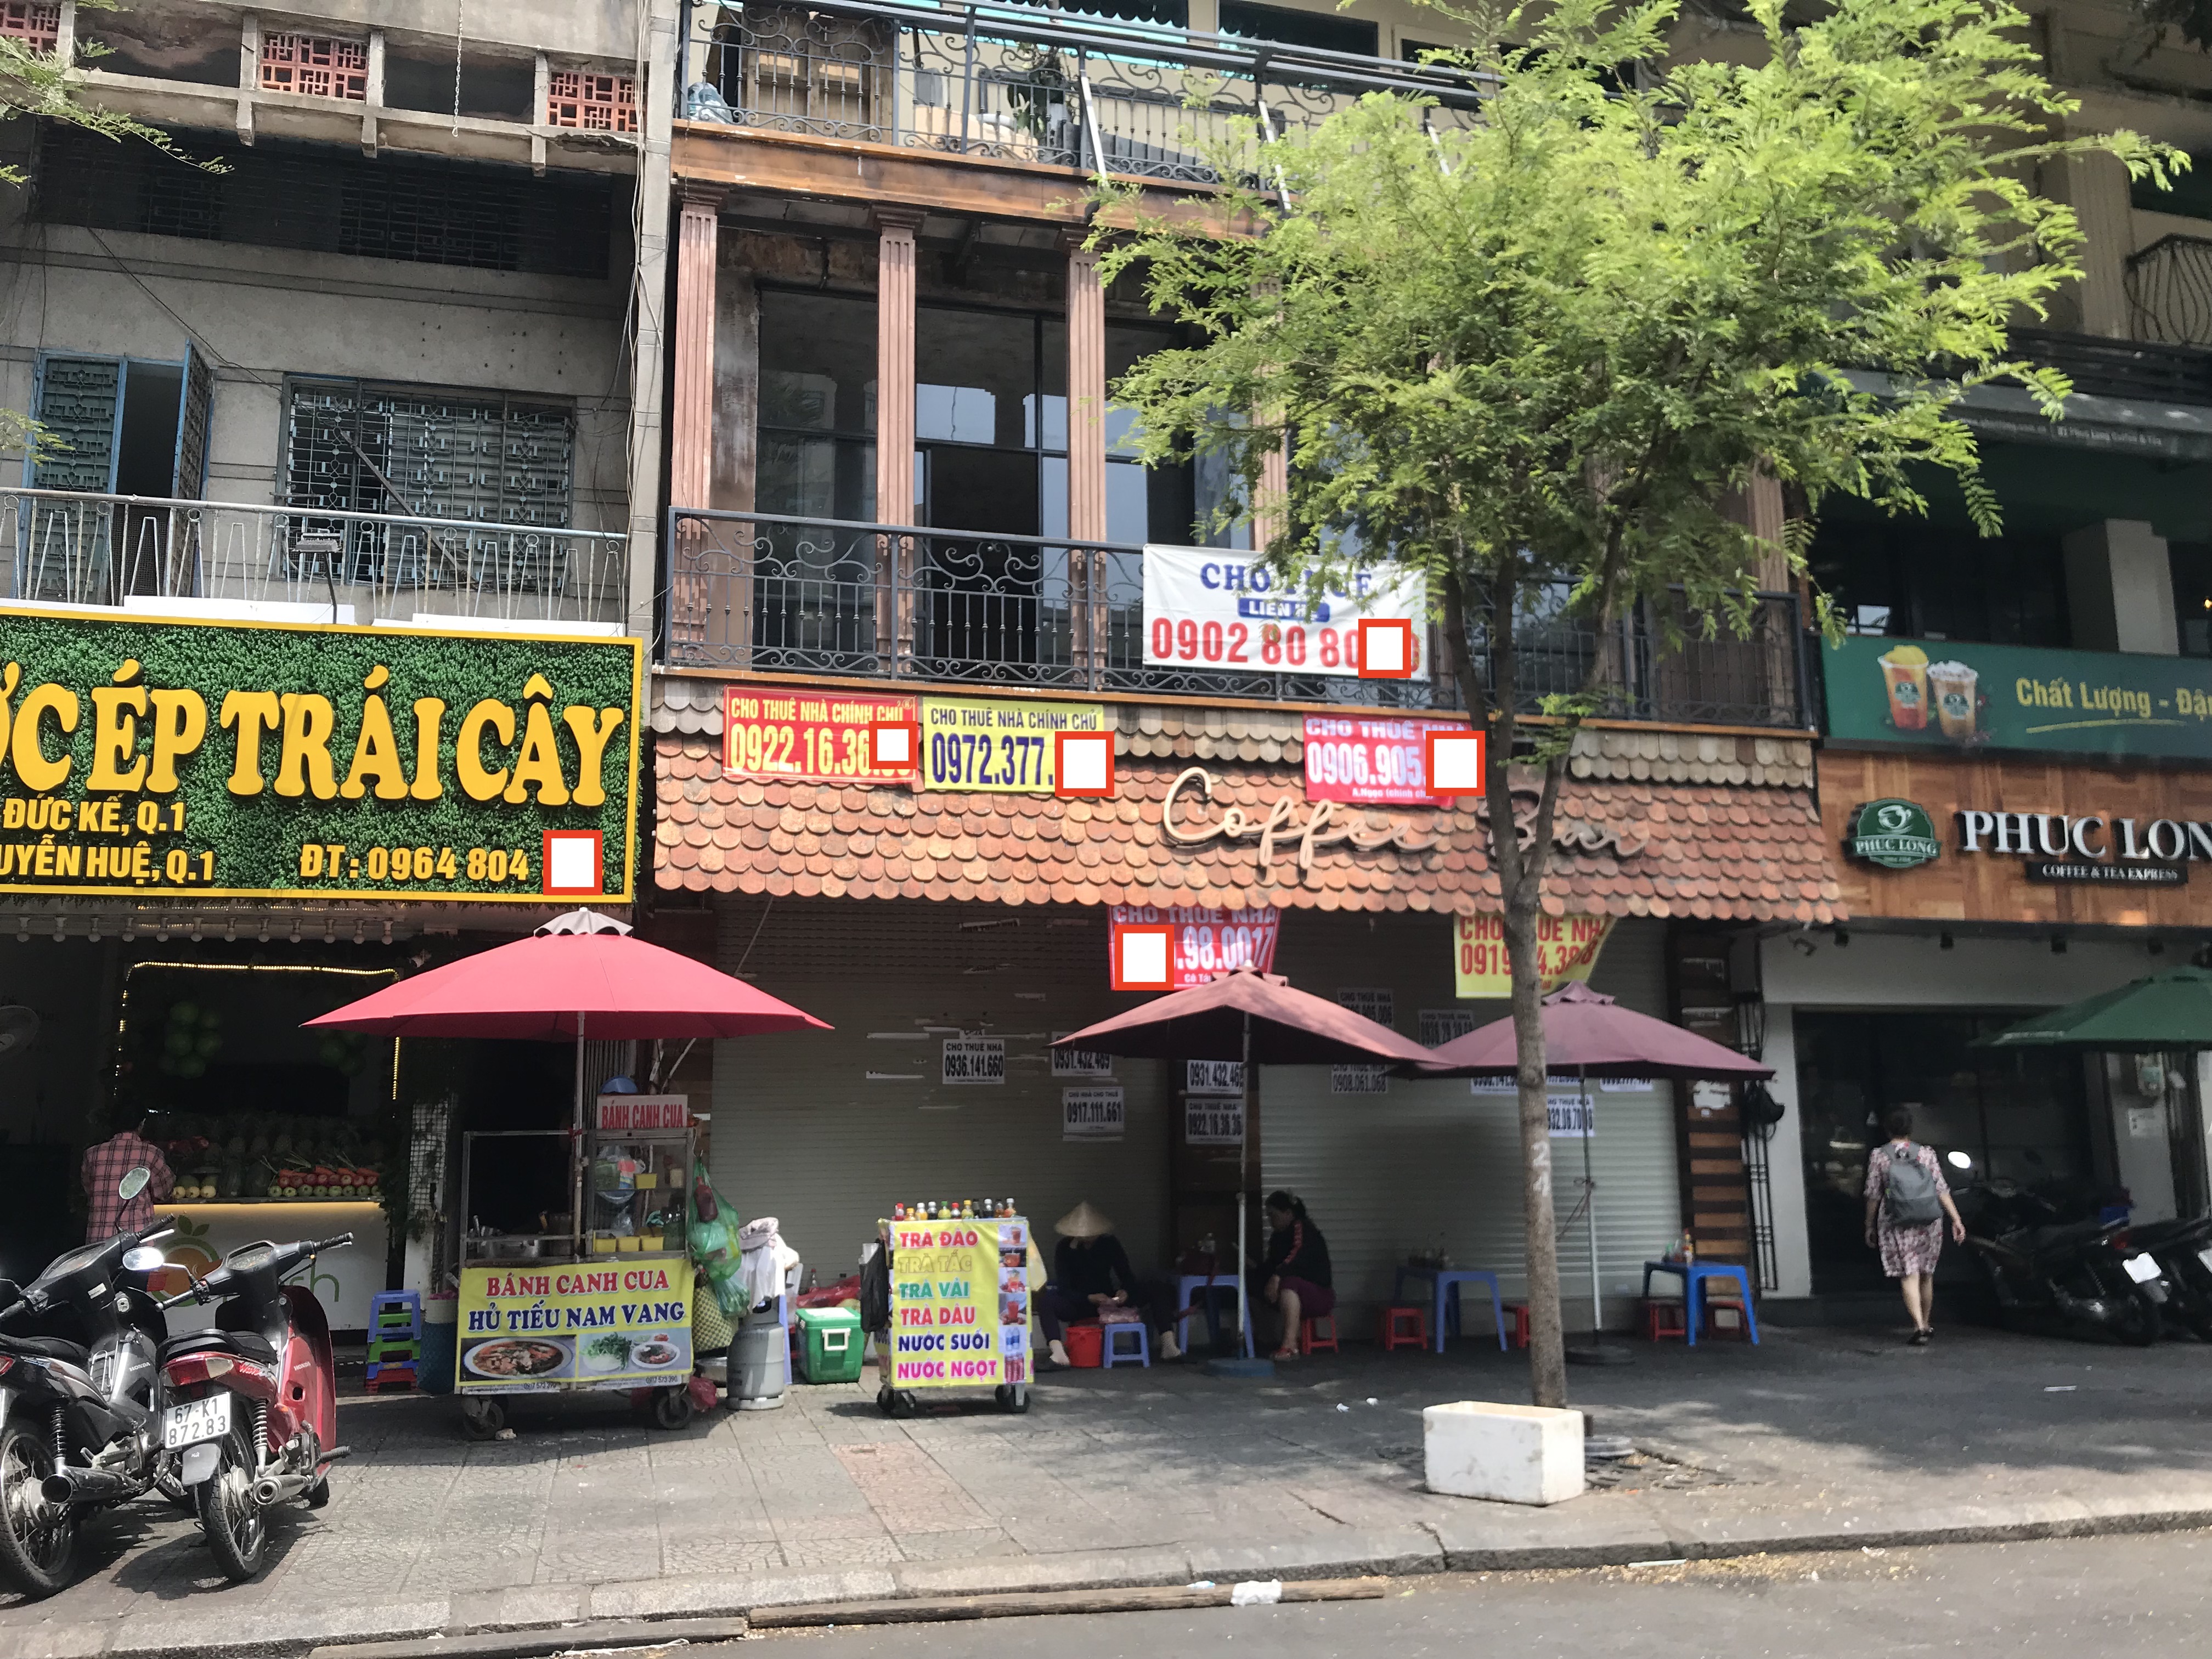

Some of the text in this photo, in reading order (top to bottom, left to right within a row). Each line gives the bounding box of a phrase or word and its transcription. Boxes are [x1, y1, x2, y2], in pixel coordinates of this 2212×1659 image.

[1200, 562, 1271, 592] CHO
[1152, 617, 1249, 663] 0902
[1261, 623, 1306, 665] 80
[731, 697, 759, 719] CHO
[762, 697, 796, 721] THUÊ
[800, 698, 828, 722] NHÀ
[832, 700, 873, 724] CHÍNH
[877, 700, 903, 721] CHỦ
[2016, 677, 2074, 709] Chất
[2079, 682, 2151, 718] Lượng
[2176, 687, 2212, 721] Đậ
[930, 706, 1097, 730] CHO THUÊ NHÀ CHÍNH CHỦ
[1306, 719, 1352, 737] CHO
[1358, 720, 1415, 740] THUÊ
[86, 659, 207, 793] ÉP
[220, 665, 446, 800] TRÁI
[457, 673, 624, 806] CÂY
[2, 791, 185, 837] ĐỨC KẾ, Q.1
[1162, 766, 1442, 871] Coffee
[1899, 839, 1938, 855] LONG
[1961, 810, 2106, 859] PHUC
[86, 840, 160, 884] HUỆ,
[166, 849, 214, 884] Q.1
[368, 847, 456, 881] 0964
[467, 848, 529, 882] 804
[2041, 863, 2178, 881] COFFEE & TEA EXPRESS
[1113, 906, 1158, 923] CHO
[946, 1042, 962, 1051] CHO
[602, 1099, 684, 1129] BÁNH CANH CUA
[900, 1228, 978, 1248] TRÀ ĐÀO
[898, 1249, 972, 1273] TRÀ TẮC
[487, 1269, 670, 1297] BÁNH CANH CUA
[899, 1279, 934, 1299] TRÀ
[468, 1299, 685, 1330] HỦ TIẾU NAM VANG
[900, 1303, 975, 1326] TRÀ DÂU
[898, 1328, 990, 1352] NƯỚC SUỐI
[128, 1361, 151, 1372] HONDA
[293, 1361, 312, 1371] HONDA
[897, 1357, 997, 1383] NƯỚC NGỌT
[174, 1397, 218, 1425] 67-K1
[168, 1415, 226, 1446] 872.83
